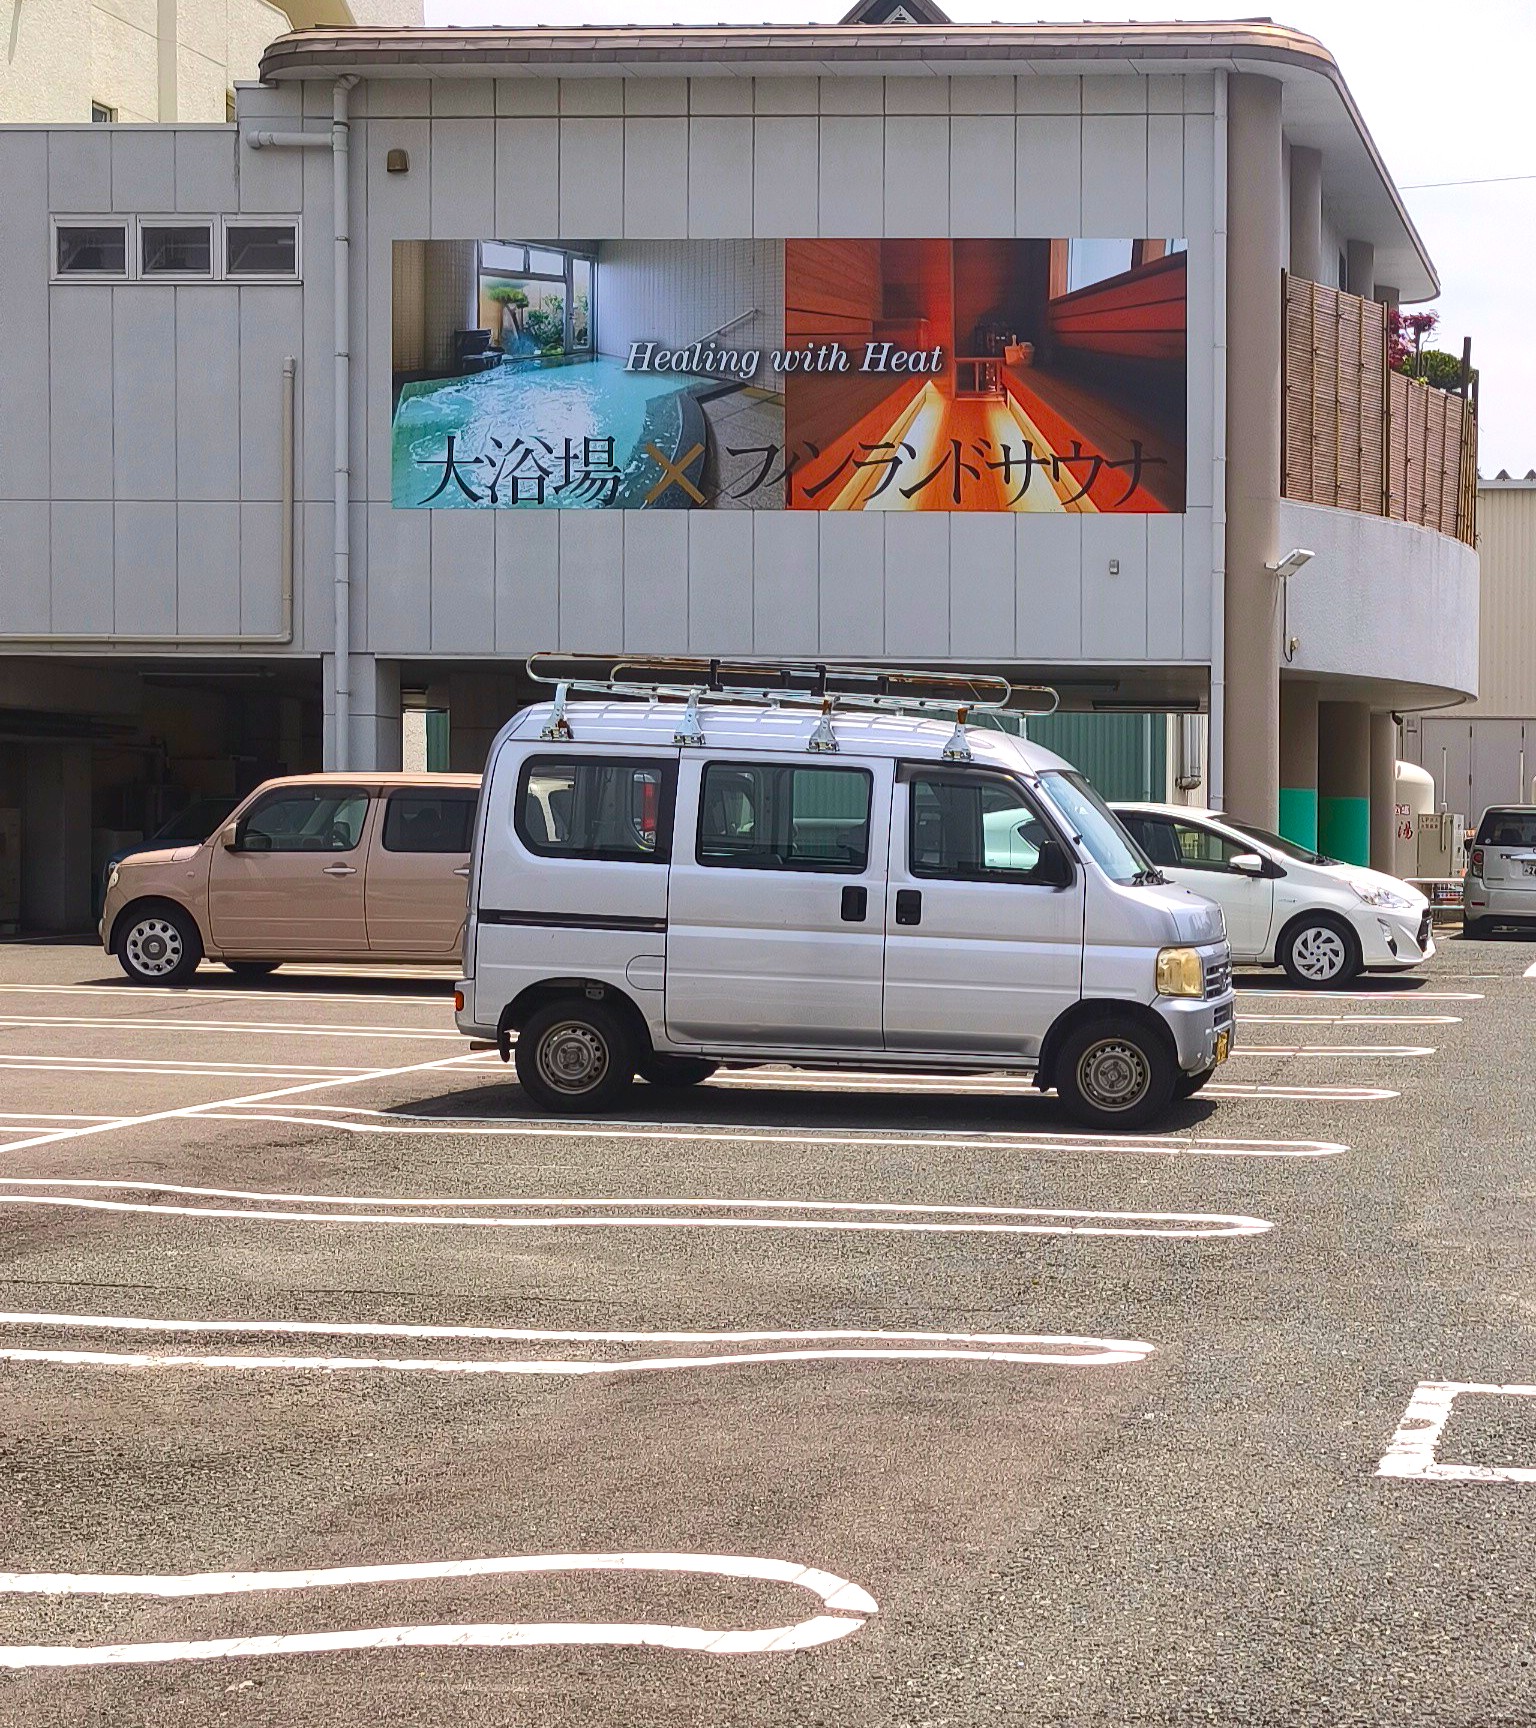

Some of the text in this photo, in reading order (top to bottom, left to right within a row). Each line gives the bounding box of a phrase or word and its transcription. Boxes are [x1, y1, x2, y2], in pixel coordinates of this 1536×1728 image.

[623, 341, 943, 379] Healing with Heat
[415, 435, 623, 506] 大浴場
[725, 436, 1169, 507] フィンランドサウナ
